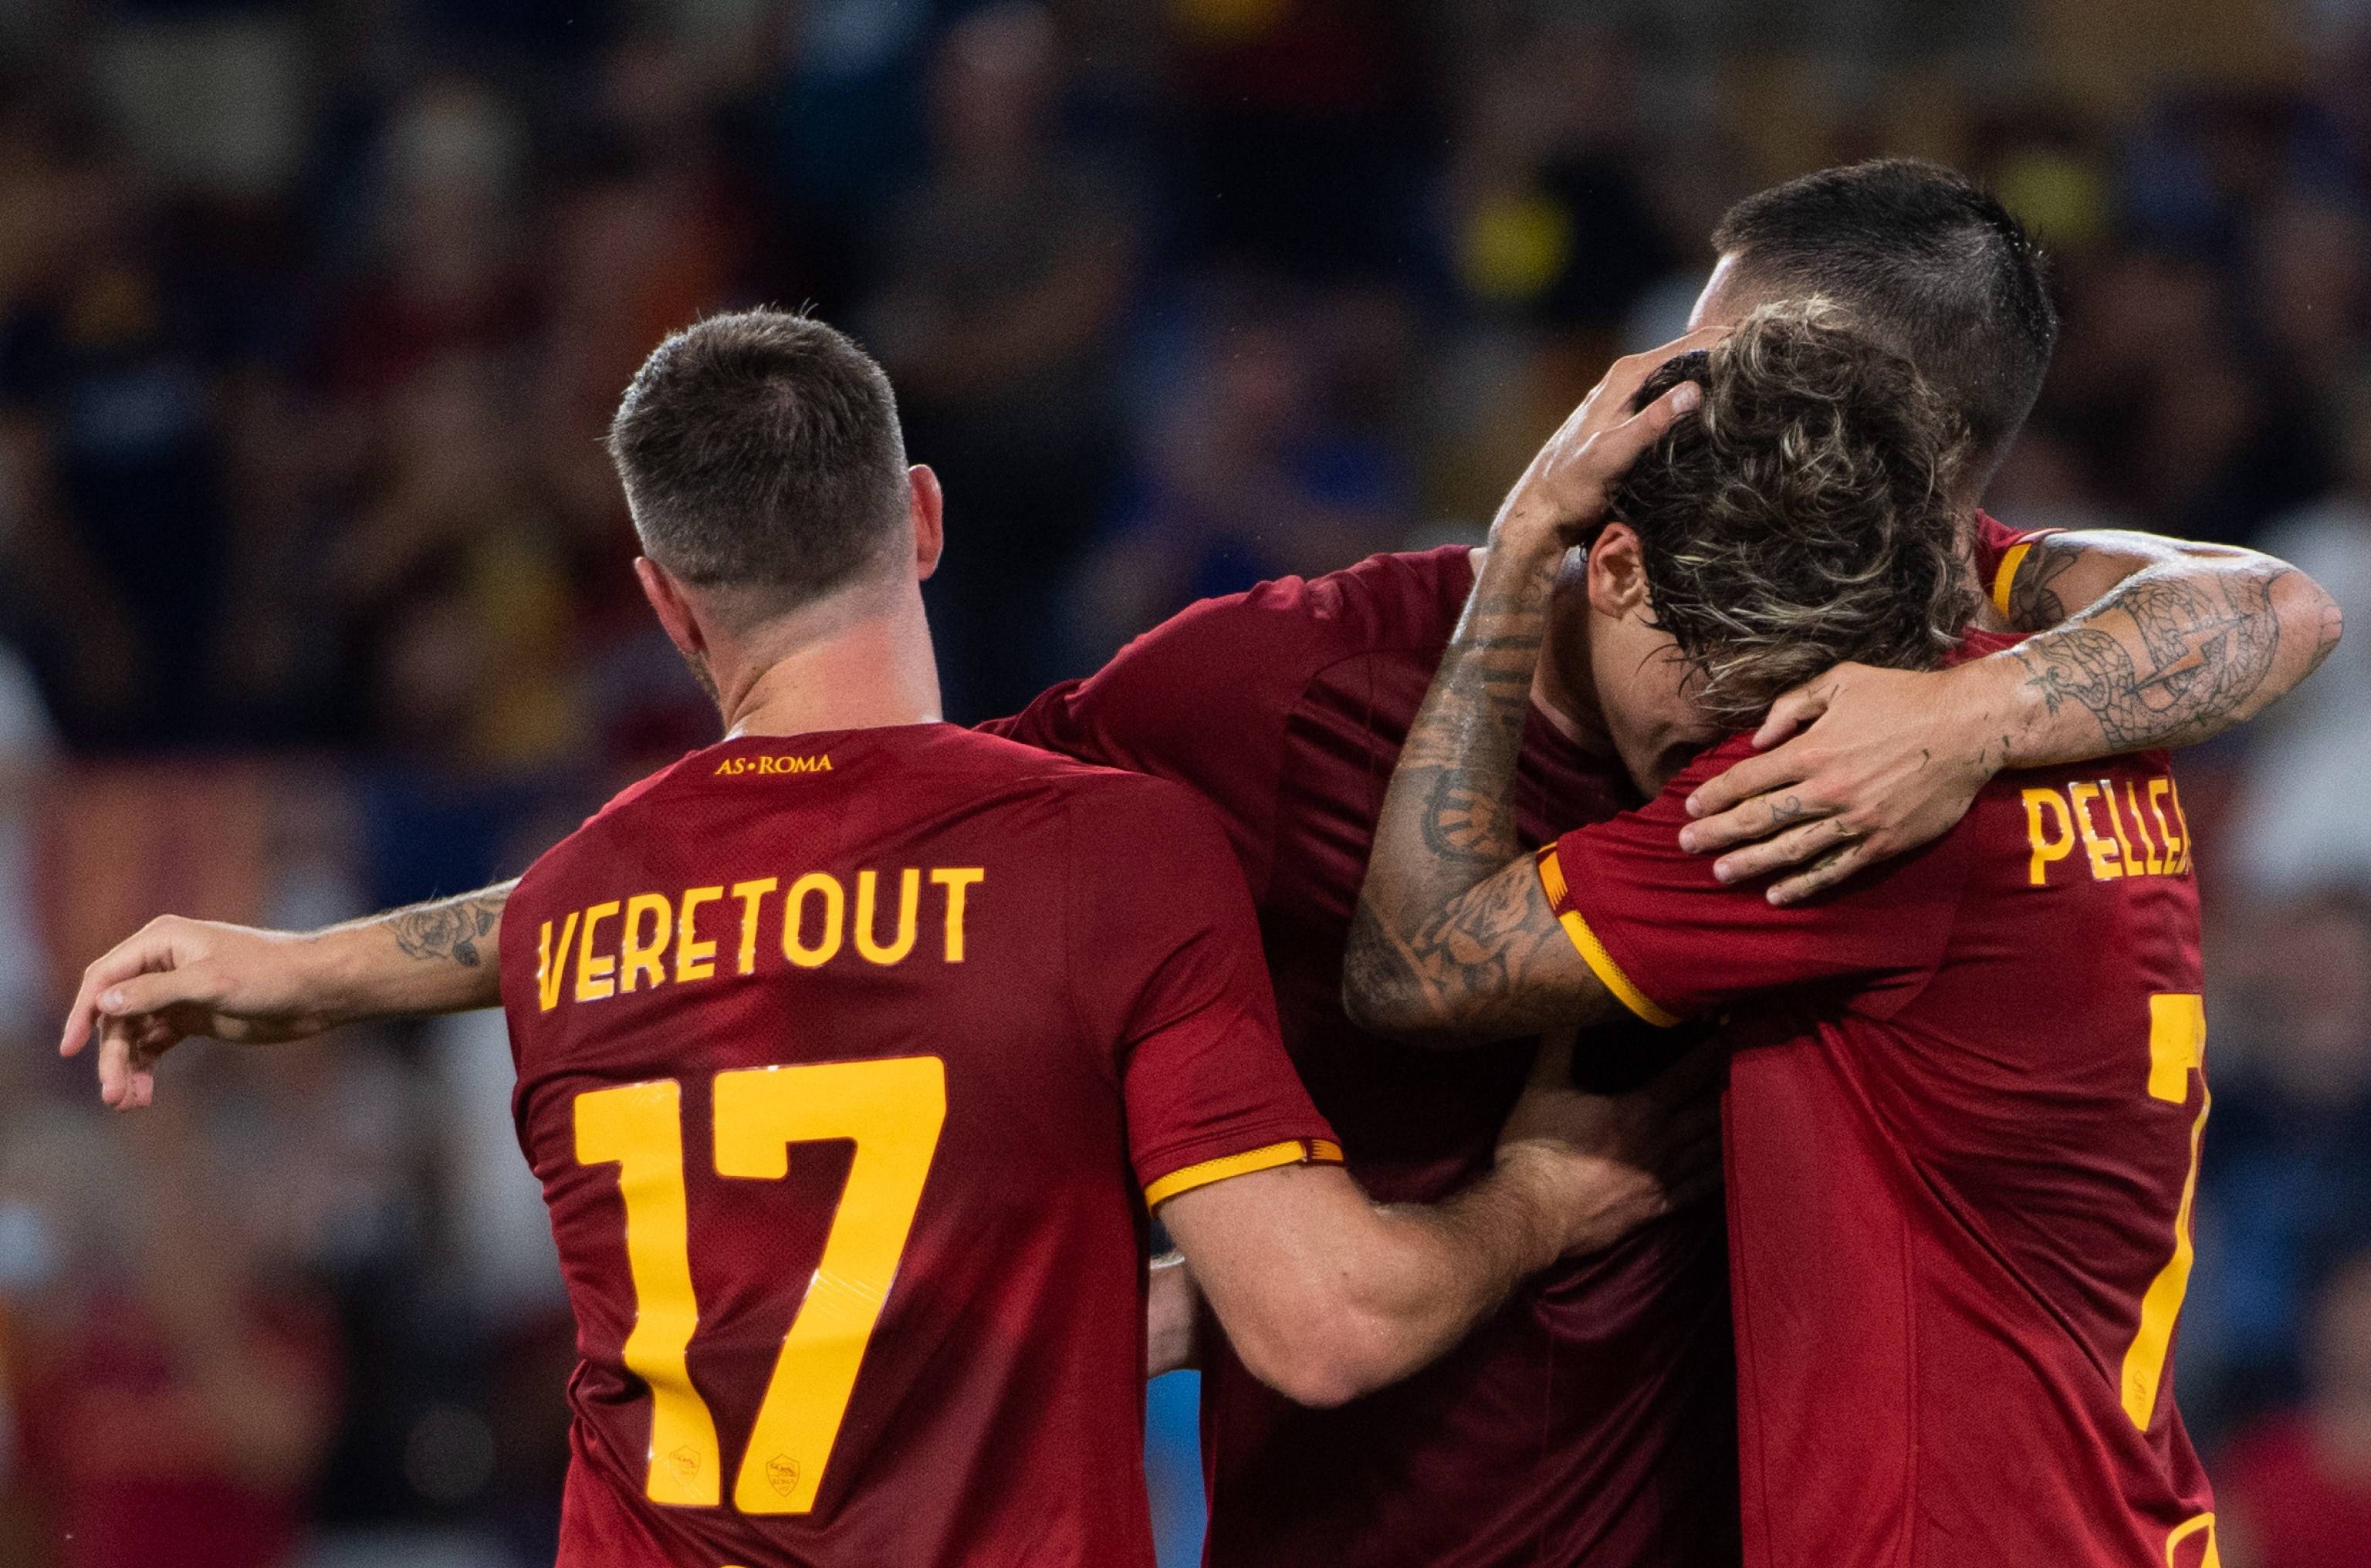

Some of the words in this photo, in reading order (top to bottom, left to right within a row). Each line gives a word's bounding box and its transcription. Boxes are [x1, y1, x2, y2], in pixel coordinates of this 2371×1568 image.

[2021, 778, 2192, 885] PELLE
[538, 867, 985, 1012] VERETOUT
[573, 1056, 947, 1515] 17
